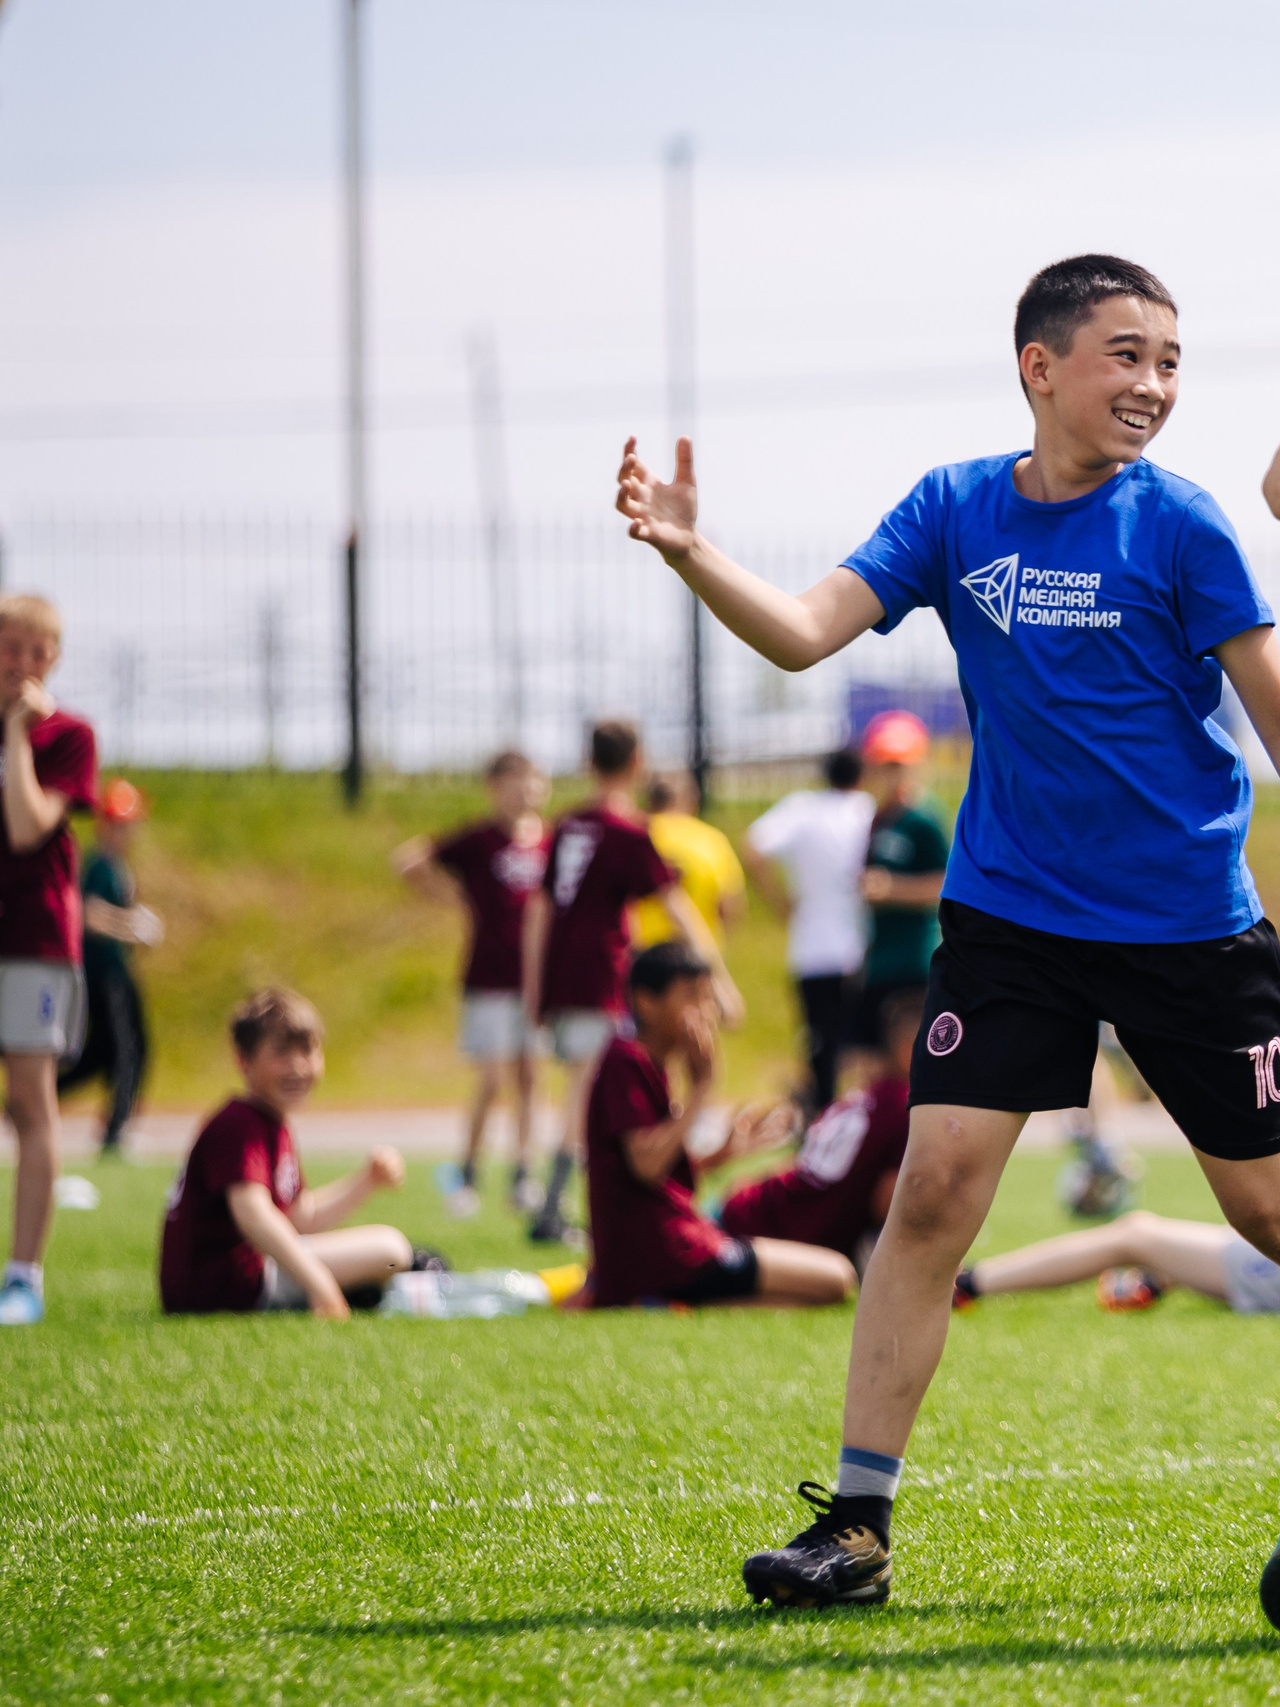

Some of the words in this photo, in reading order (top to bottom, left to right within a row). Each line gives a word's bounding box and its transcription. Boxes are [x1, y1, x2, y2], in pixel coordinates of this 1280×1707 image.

[1021, 567, 1102, 590] РУССКАЯ
[1018, 587, 1096, 608] МЕДНАЯ
[1016, 606, 1122, 629] КОМПАНИЯ
